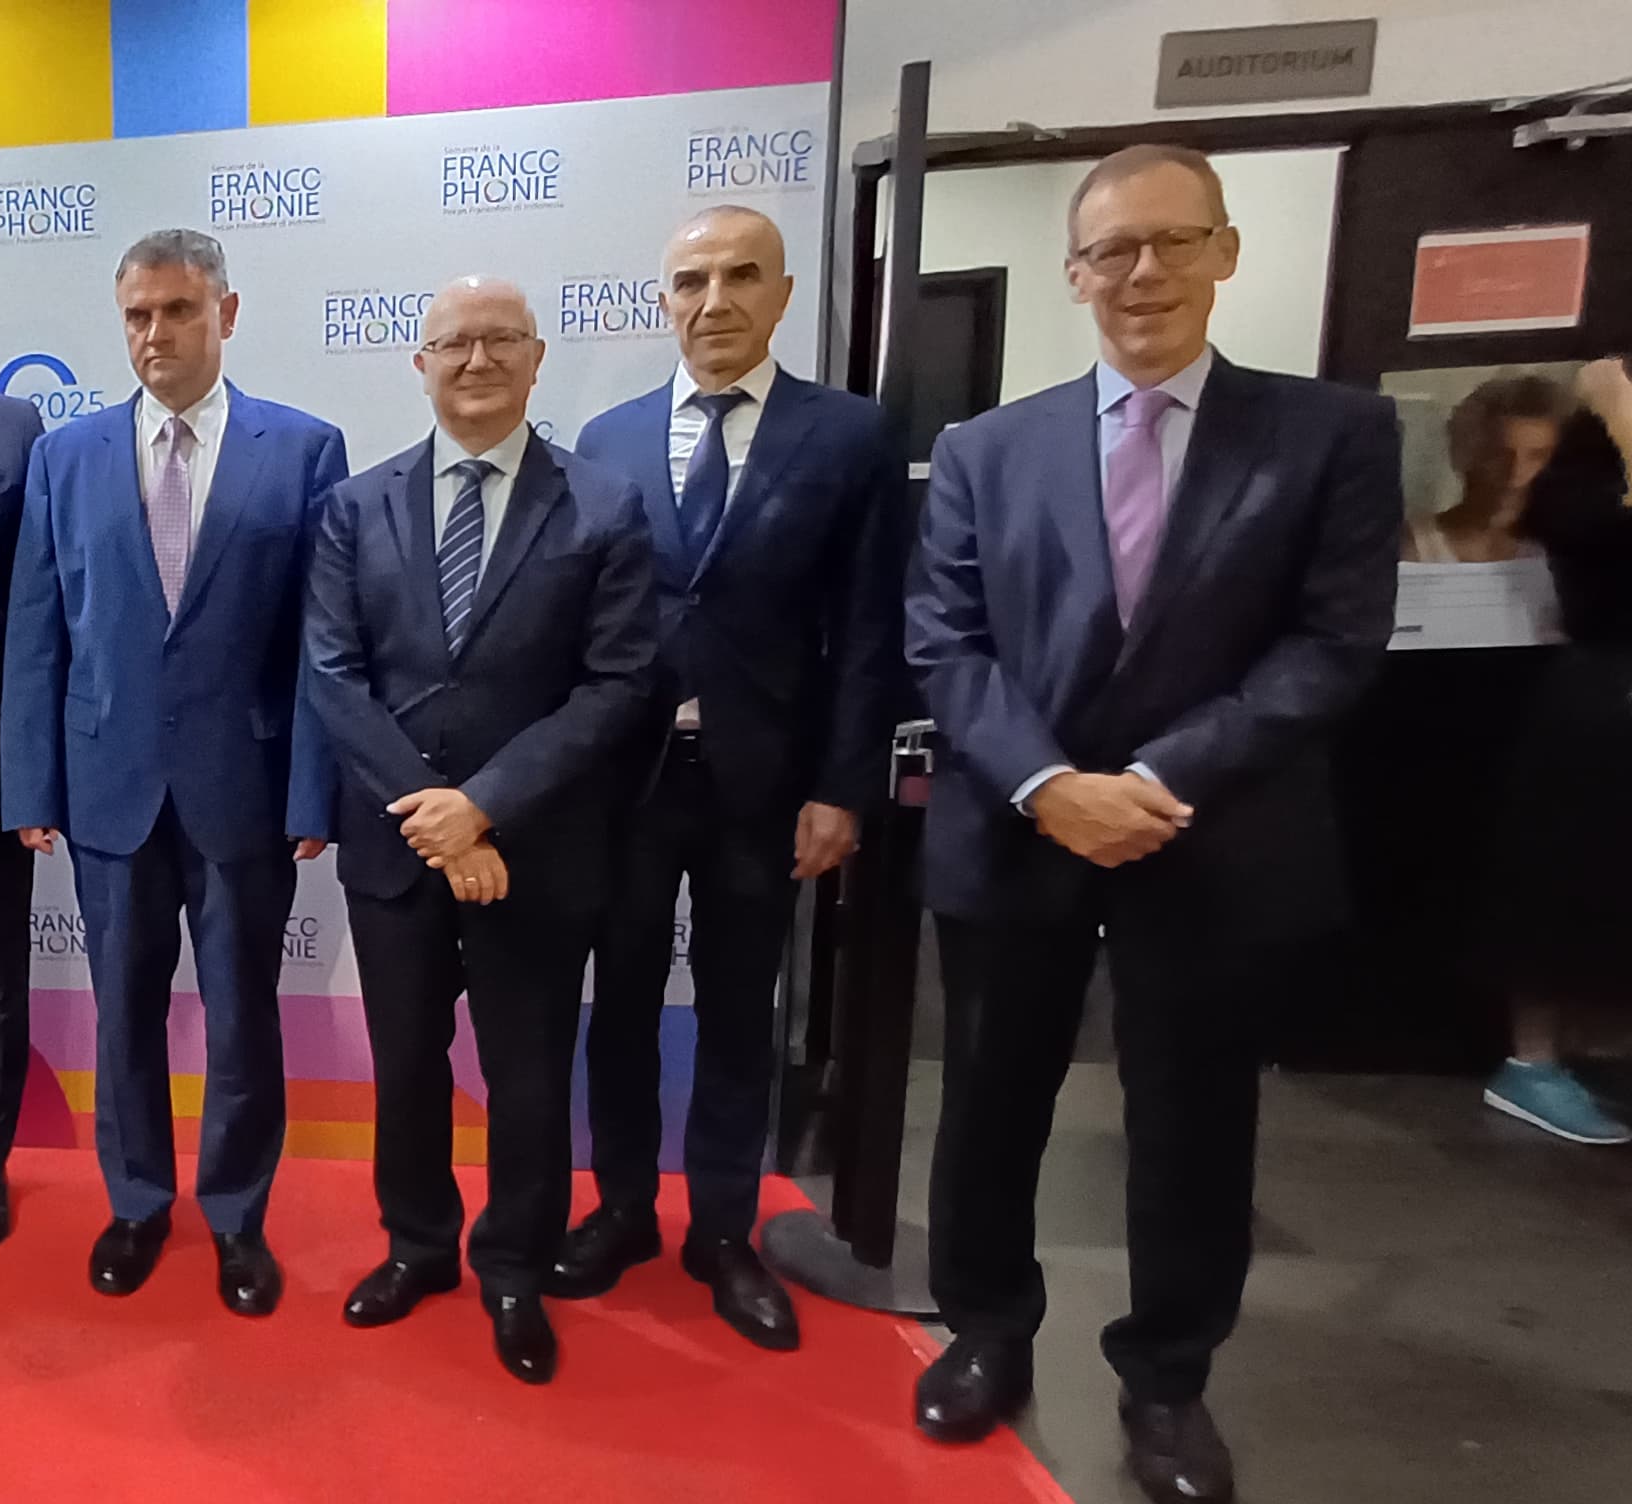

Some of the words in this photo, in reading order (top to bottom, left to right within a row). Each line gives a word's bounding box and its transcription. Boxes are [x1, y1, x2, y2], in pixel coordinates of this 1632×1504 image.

[1176, 48, 1357, 79] AUDITORIUM
[687, 156, 809, 189] PHONIE
[443, 175, 557, 206] PHONIE
[211, 192, 320, 222] PHONIE
[561, 279, 659, 309] FRANC
[325, 319, 418, 346] PHONI
[560, 306, 664, 334] PHONI
